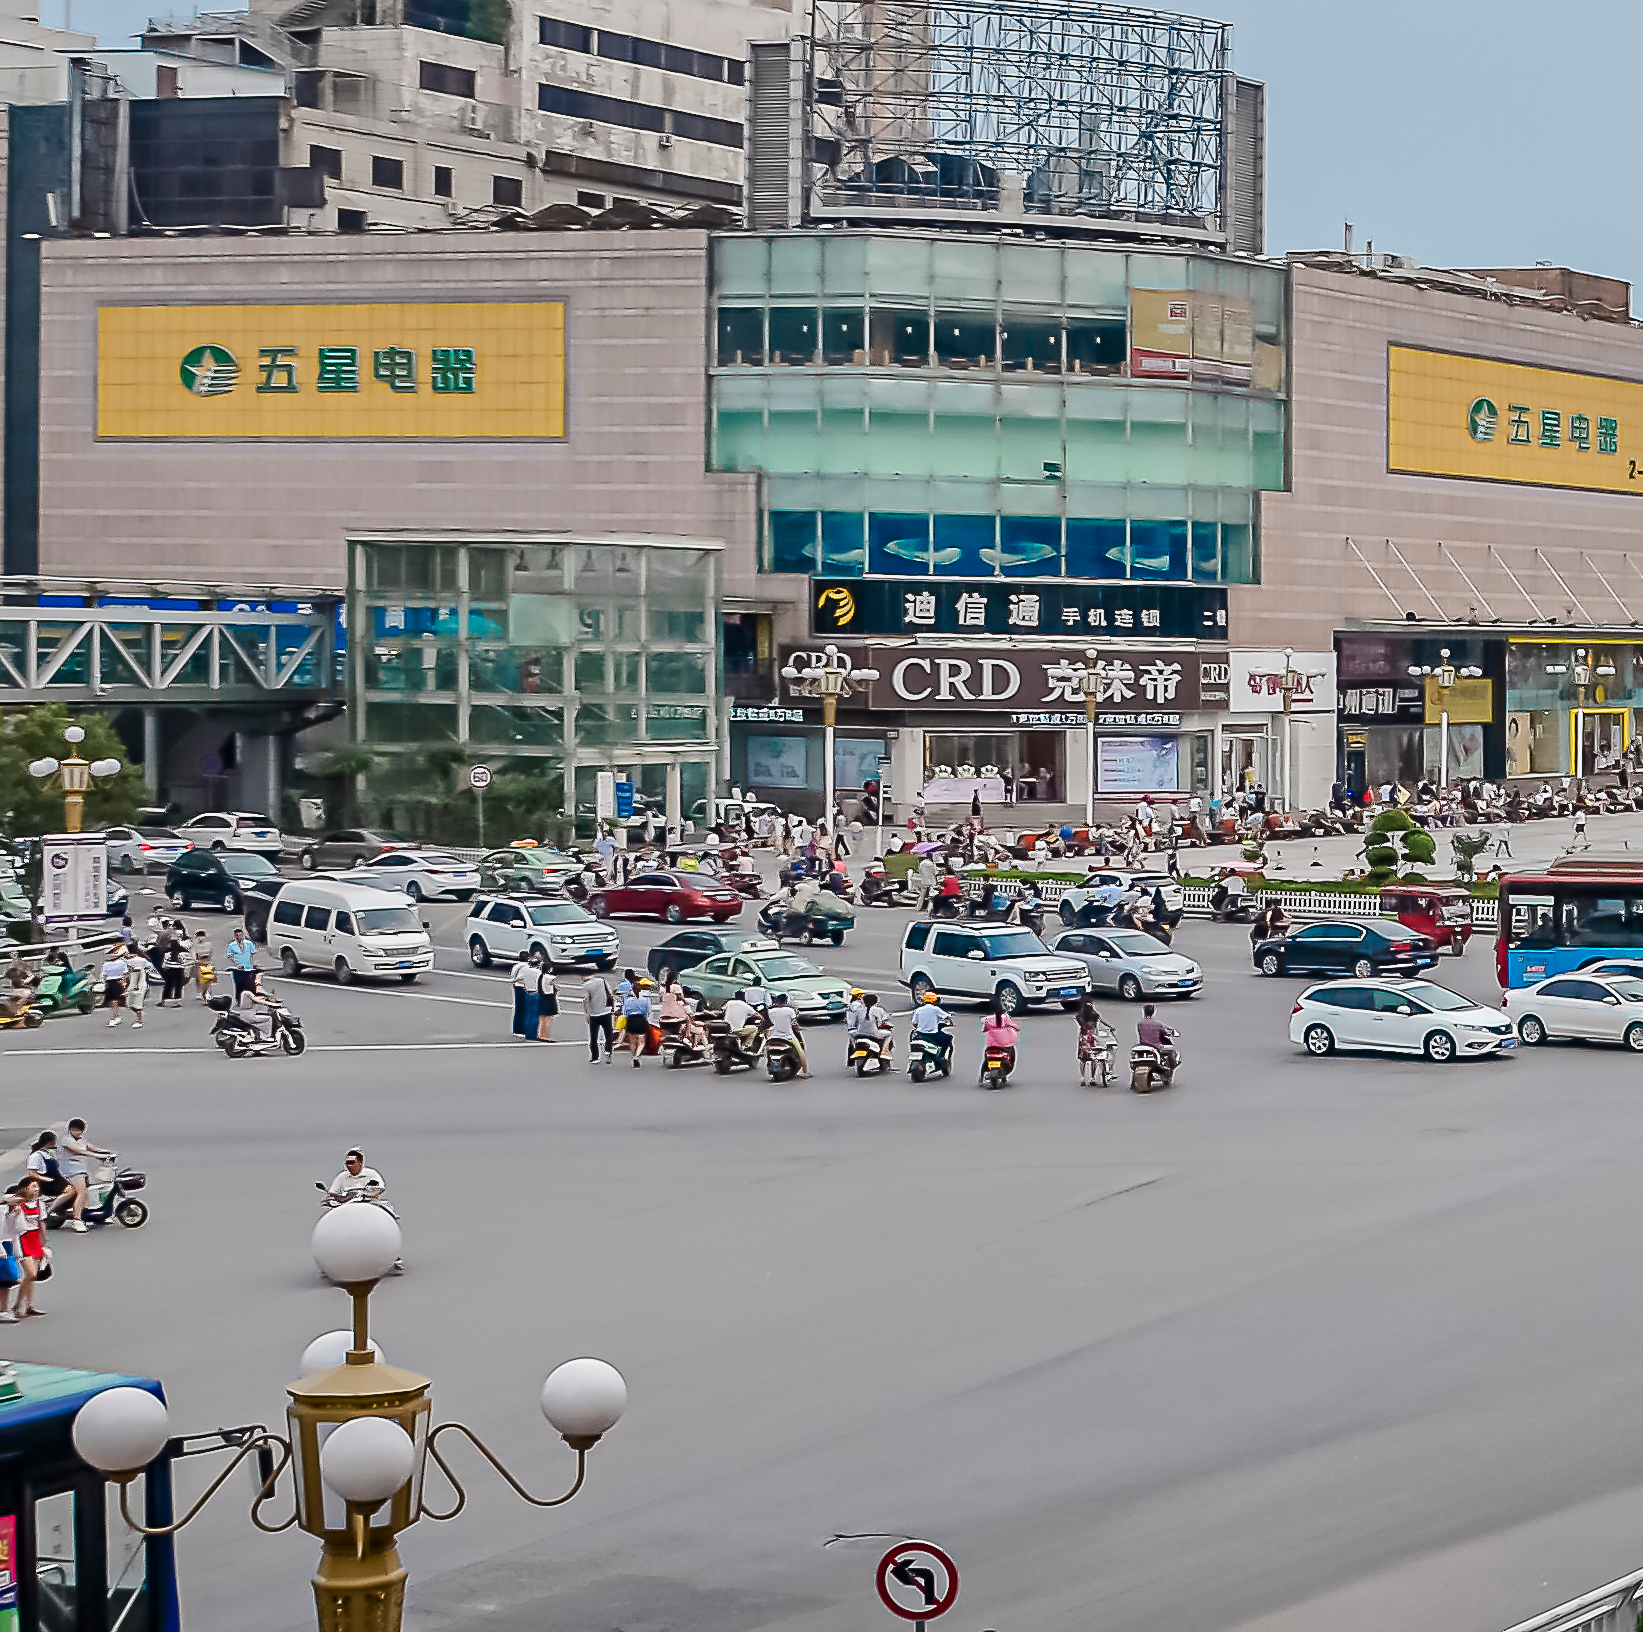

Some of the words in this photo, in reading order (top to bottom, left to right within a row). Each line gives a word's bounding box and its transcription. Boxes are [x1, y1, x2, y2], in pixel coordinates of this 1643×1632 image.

[256, 344, 476, 394] 五星电器
[1507, 403, 1617, 454] 五星电器
[889, 657, 1020, 704] CRD
